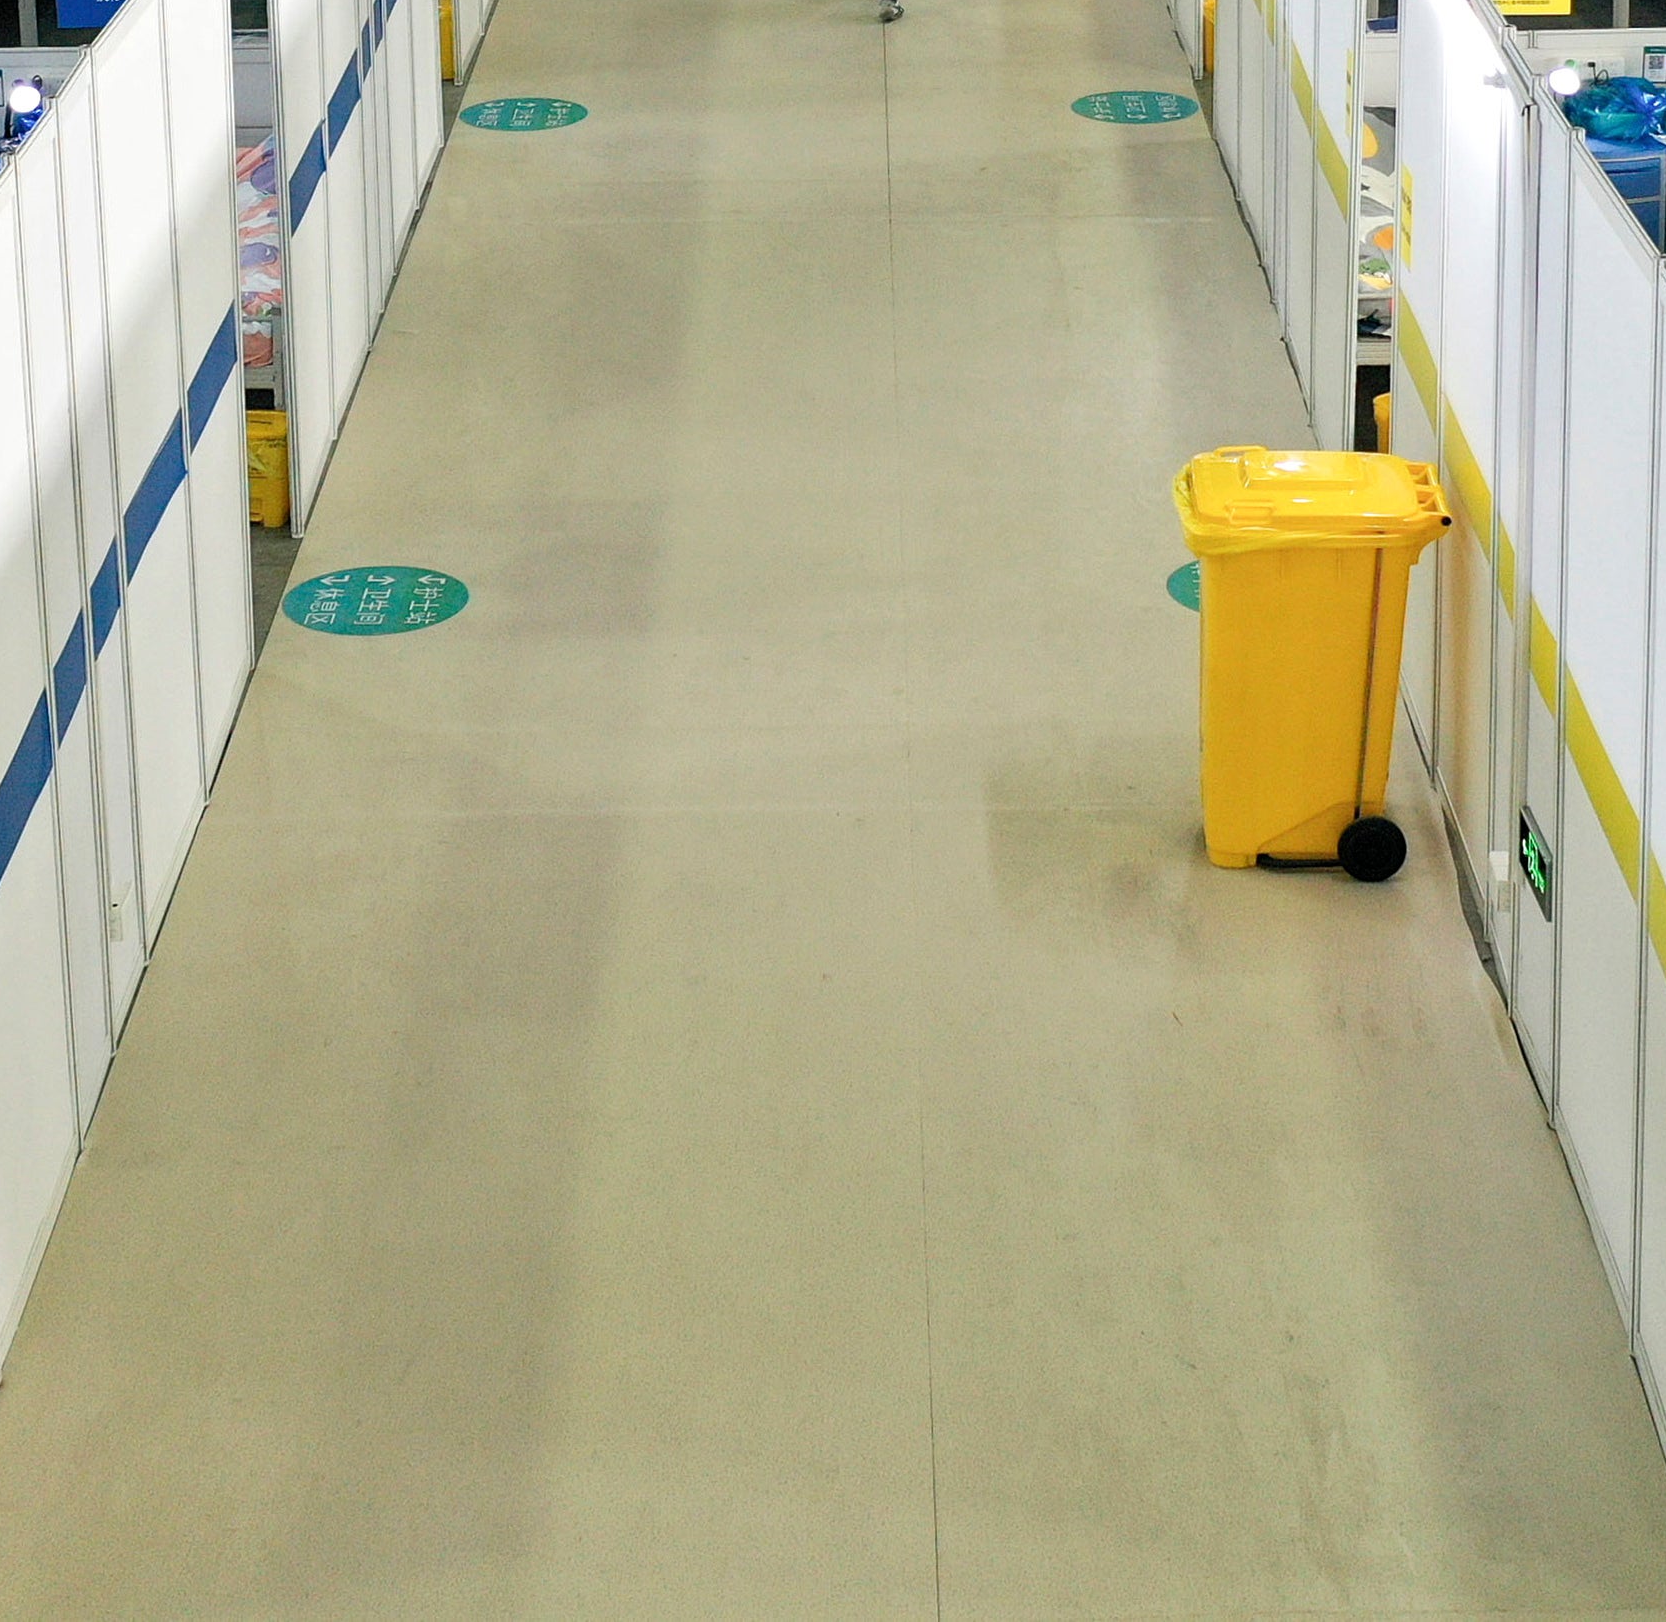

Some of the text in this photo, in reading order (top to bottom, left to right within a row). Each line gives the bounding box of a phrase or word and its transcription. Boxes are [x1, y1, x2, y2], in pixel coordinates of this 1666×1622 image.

[305, 588, 343, 625] 休息区
[354, 588, 393, 625] 卫生间
[404, 588, 444, 625] 护士站
